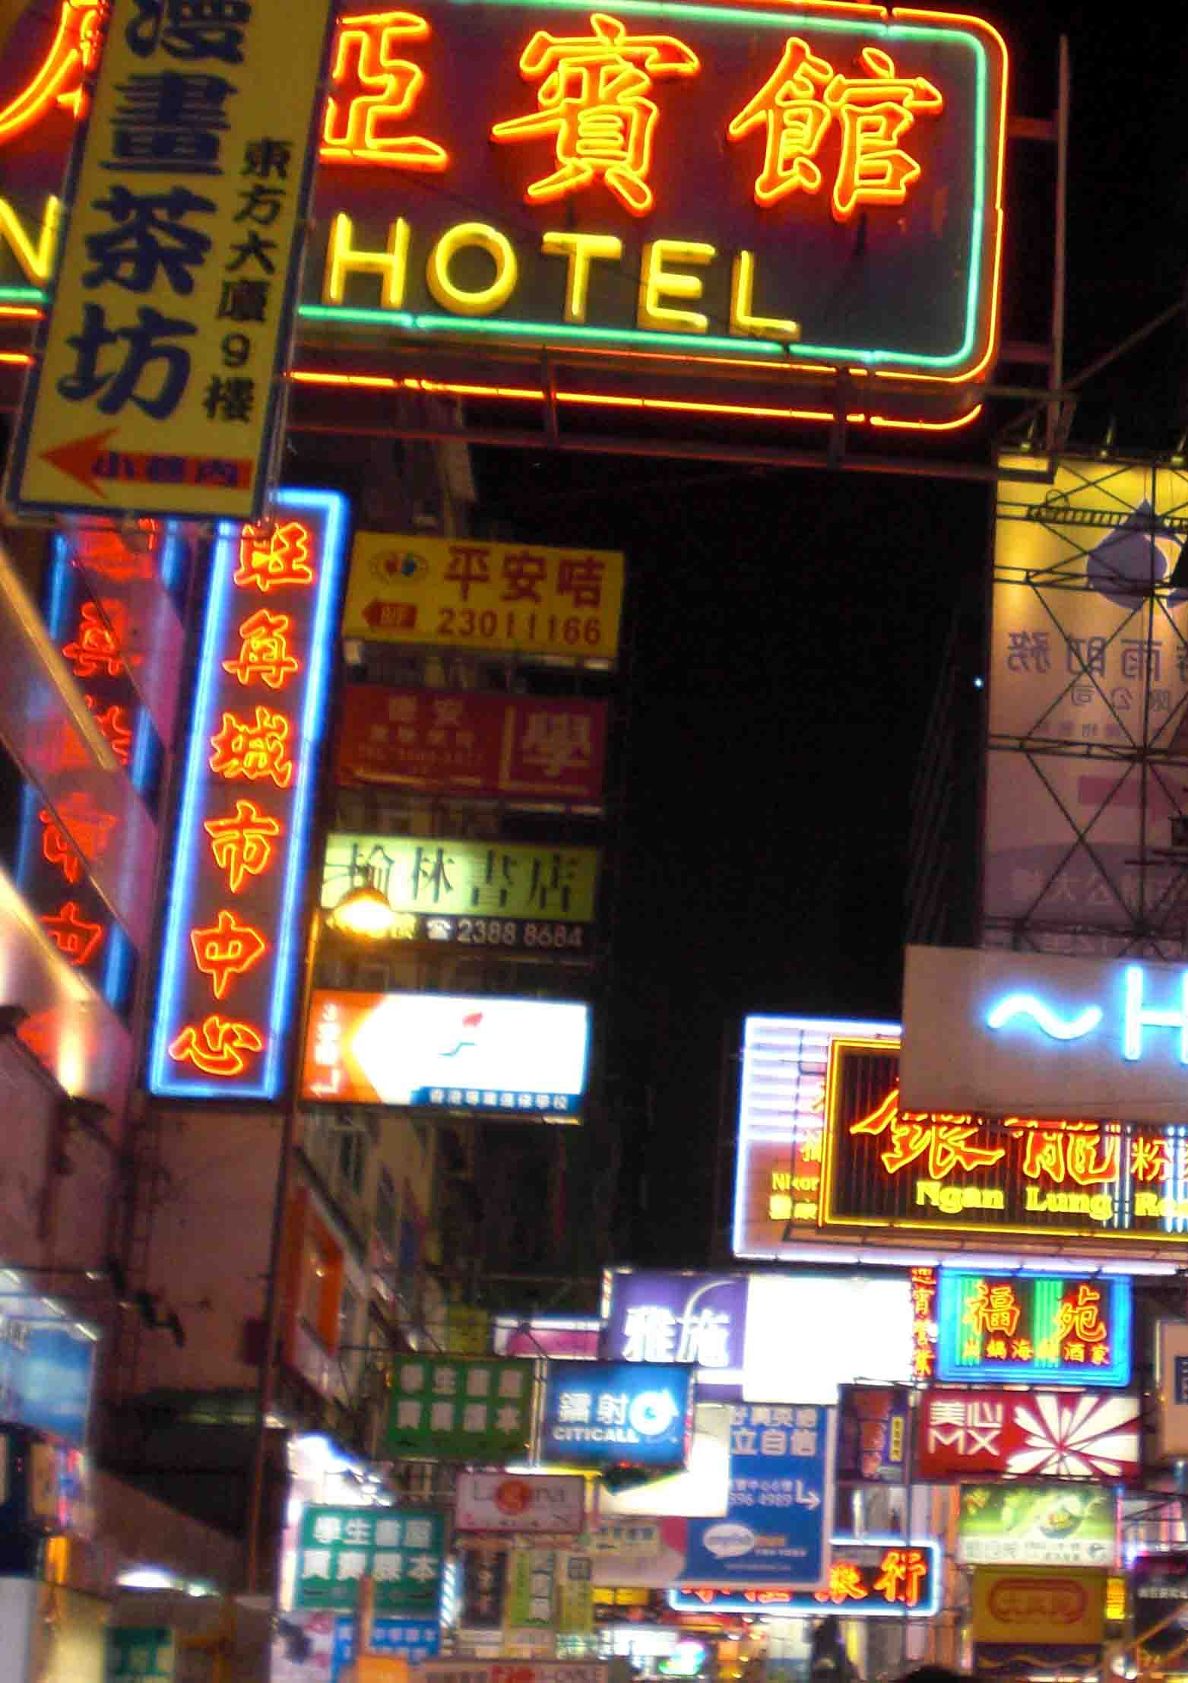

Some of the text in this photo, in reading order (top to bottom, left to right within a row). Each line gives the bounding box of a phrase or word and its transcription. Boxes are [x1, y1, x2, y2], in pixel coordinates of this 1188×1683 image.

[57, 0, 252, 420] 漫畫茶坊
[323, 212, 800, 341] HOTEL
[915, 1180, 1005, 1214] Ngan
[1025, 1185, 1113, 1221] Lung
[929, 1401, 1004, 1428] 美心
[926, 1428, 1003, 1457] MX
